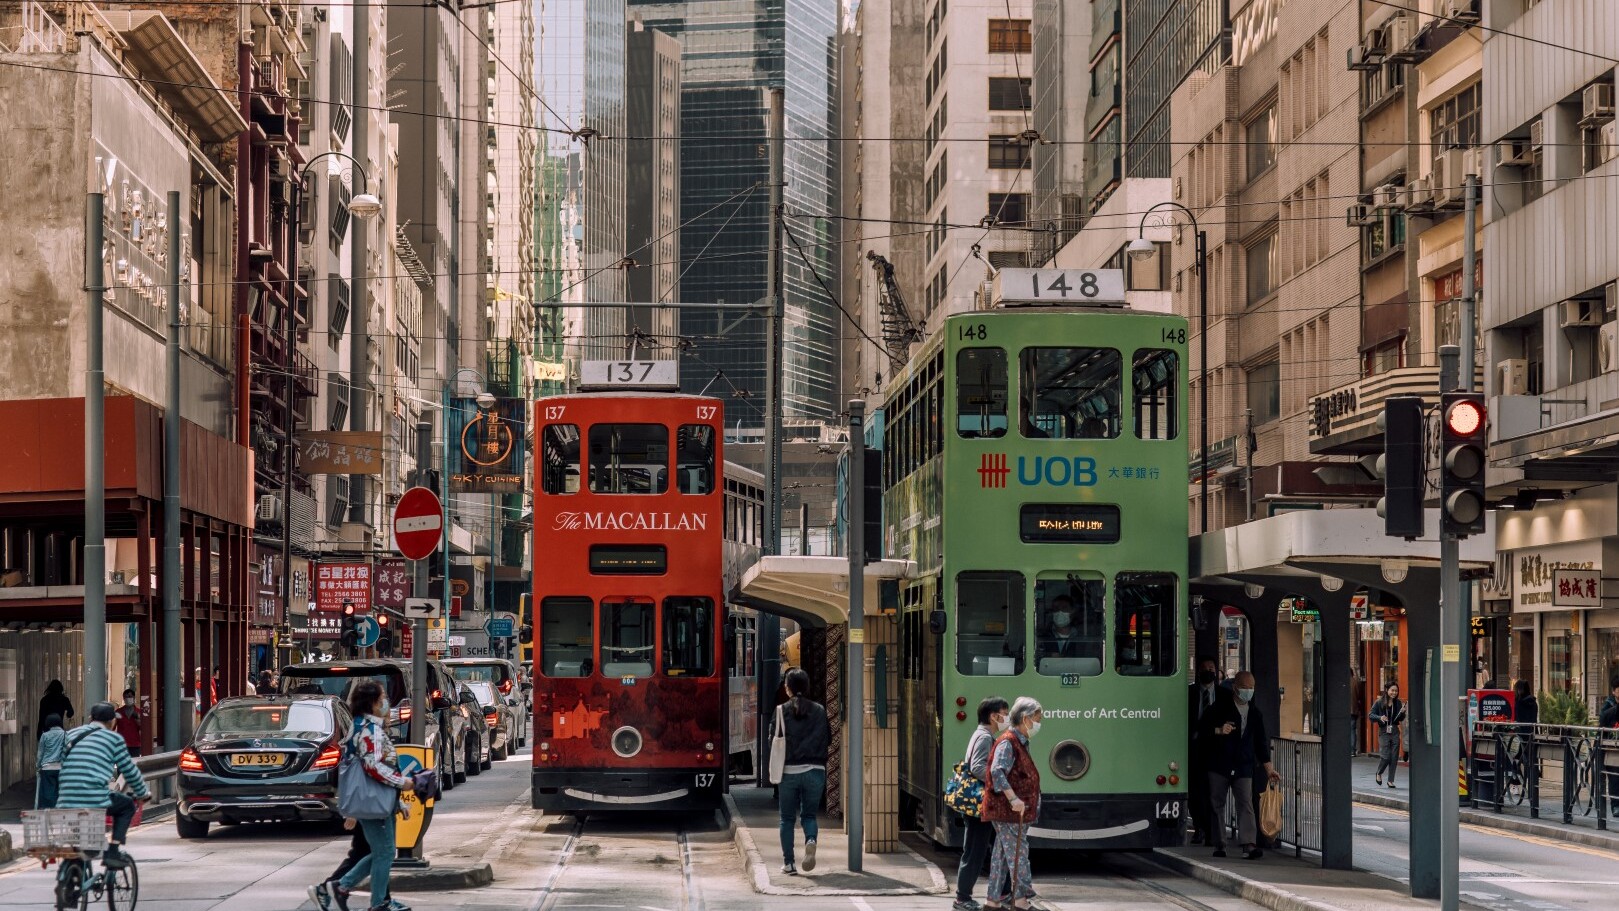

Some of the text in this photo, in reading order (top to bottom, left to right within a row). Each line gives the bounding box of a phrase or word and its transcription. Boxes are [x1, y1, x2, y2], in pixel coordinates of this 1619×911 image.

[1032, 272, 1099, 298] 148
[959, 324, 987, 341] 148
[1162, 328, 1186, 344] 148
[607, 362, 655, 382] 137
[545, 406, 566, 420] 137
[696, 406, 717, 420] 137
[1018, 456, 1098, 486] UOB
[1108, 466, 1160, 480] 大華銀行
[552, 511, 708, 531] The MACALLAN
[319, 566, 368, 579] 吉星找換
[393, 588, 403, 602] $
[1063, 675, 1078, 685] 032
[1084, 707, 1097, 719] of
[1099, 707, 1117, 719] Art
[1120, 707, 1161, 719] Central
[238, 755, 278, 764] DV 339
[695, 774, 715, 788] 137
[1155, 801, 1180, 819] 148
